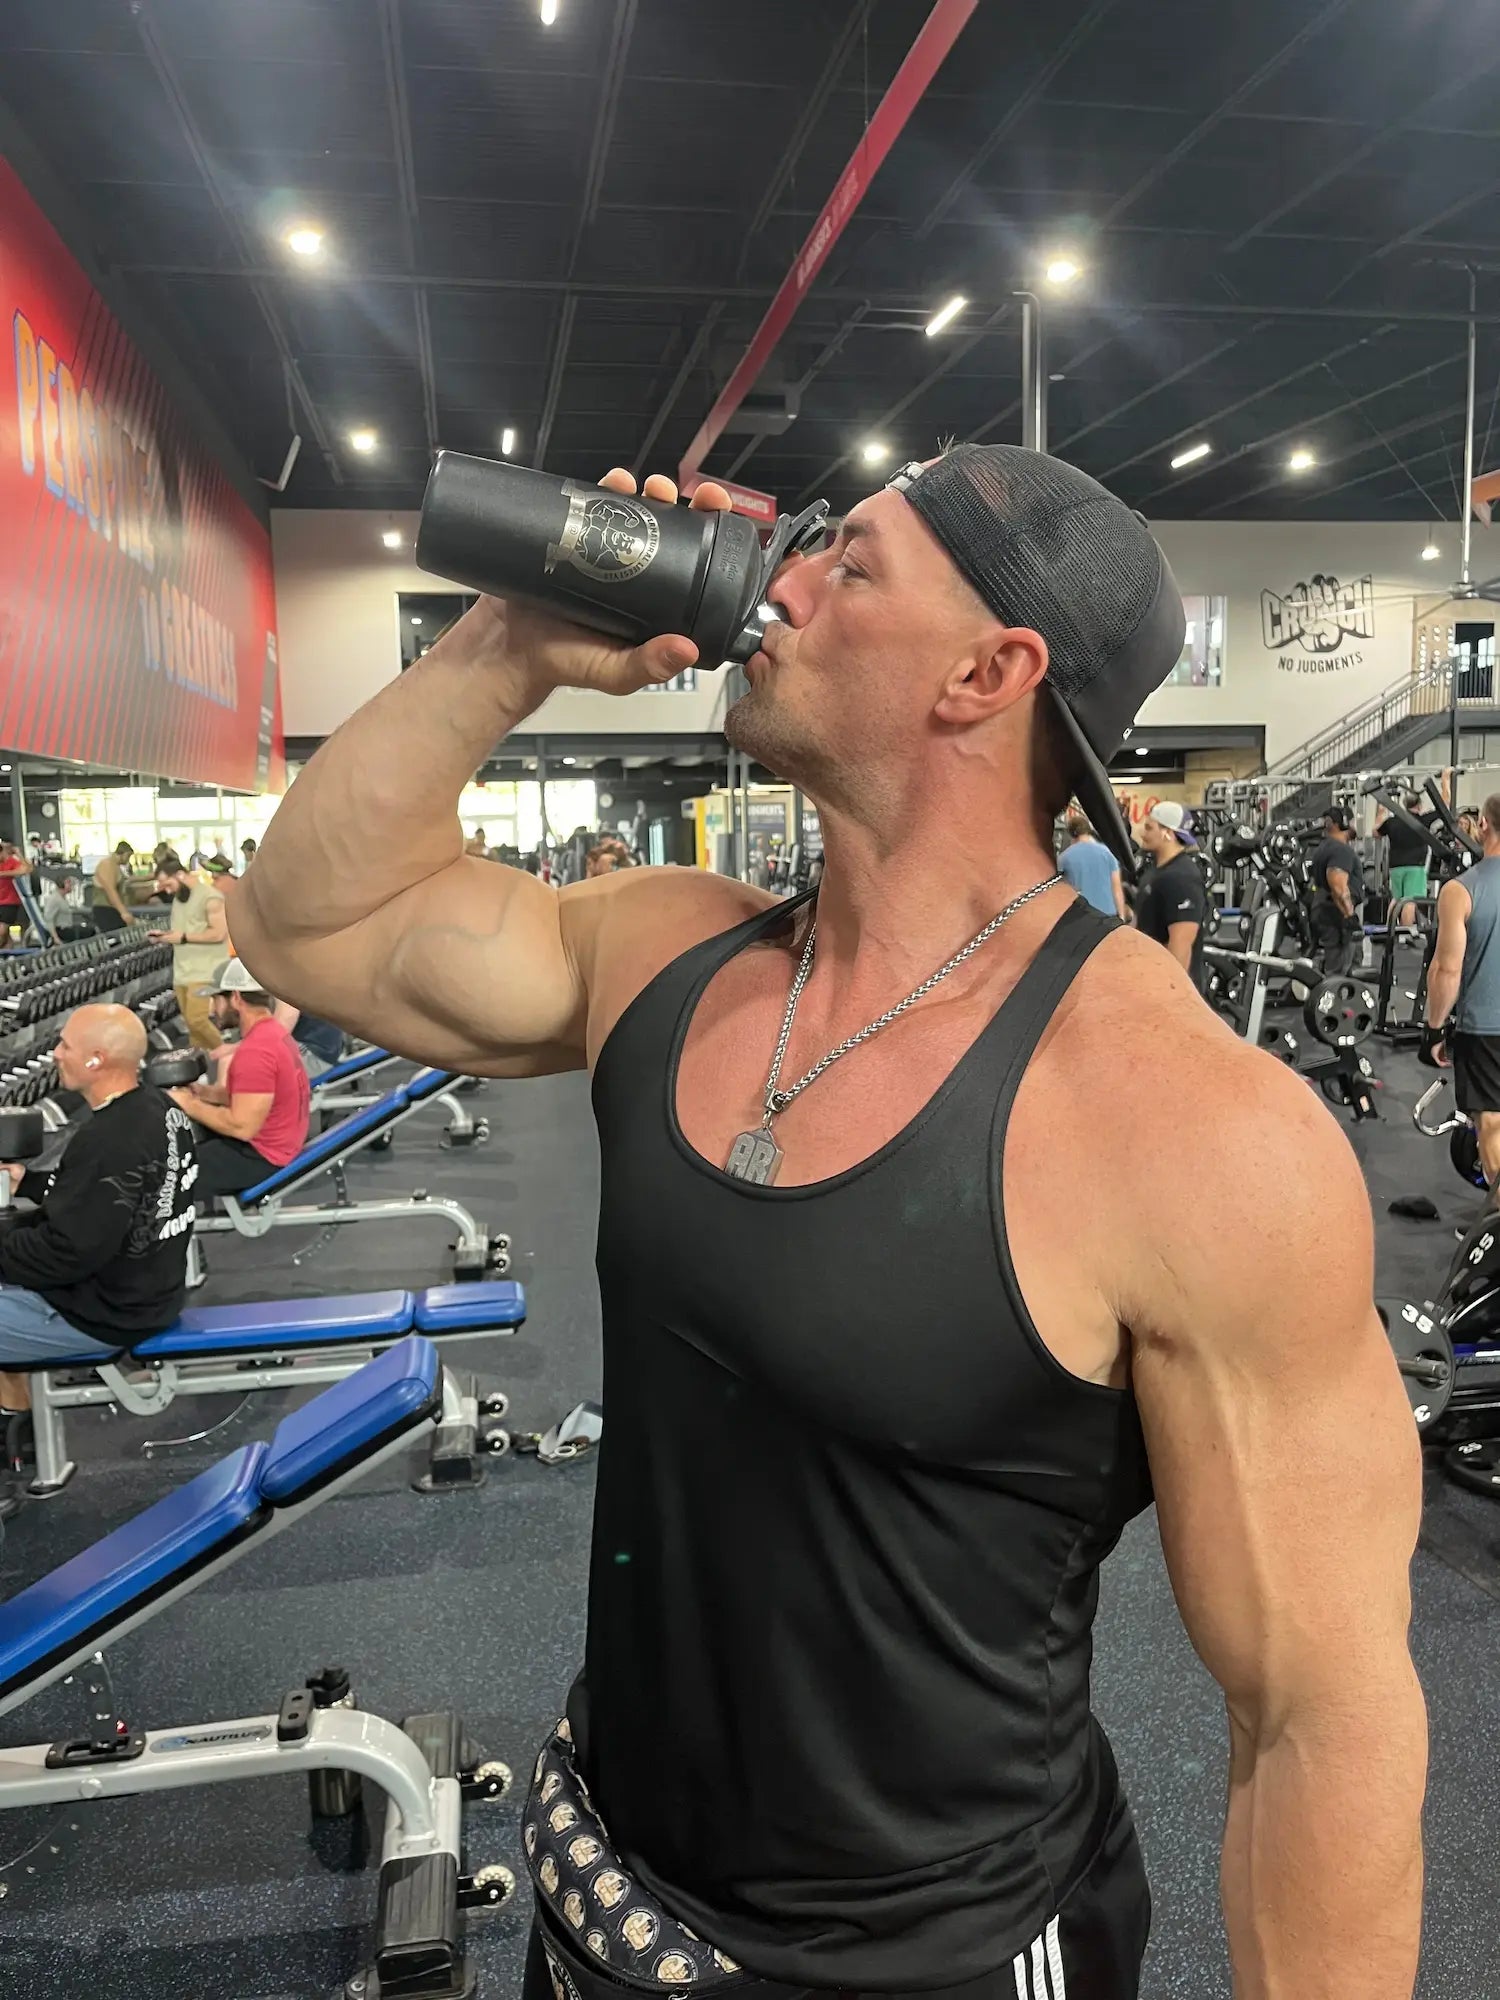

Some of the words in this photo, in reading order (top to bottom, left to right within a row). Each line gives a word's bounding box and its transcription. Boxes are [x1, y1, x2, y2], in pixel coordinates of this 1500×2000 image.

[637, 503, 659, 562] SUPERNATURAL
[603, 561, 645, 580] LIFESTYLE
[1261, 573, 1375, 650] CRUNCH
[1277, 655, 1294, 671] NO
[1296, 651, 1364, 674] JUDGMENTS
[1468, 1232, 1495, 1265] 35
[1401, 1303, 1434, 1334] 35
[1414, 1404, 1431, 1423] 3
[184, 1731, 263, 1745] NAUTILUS
